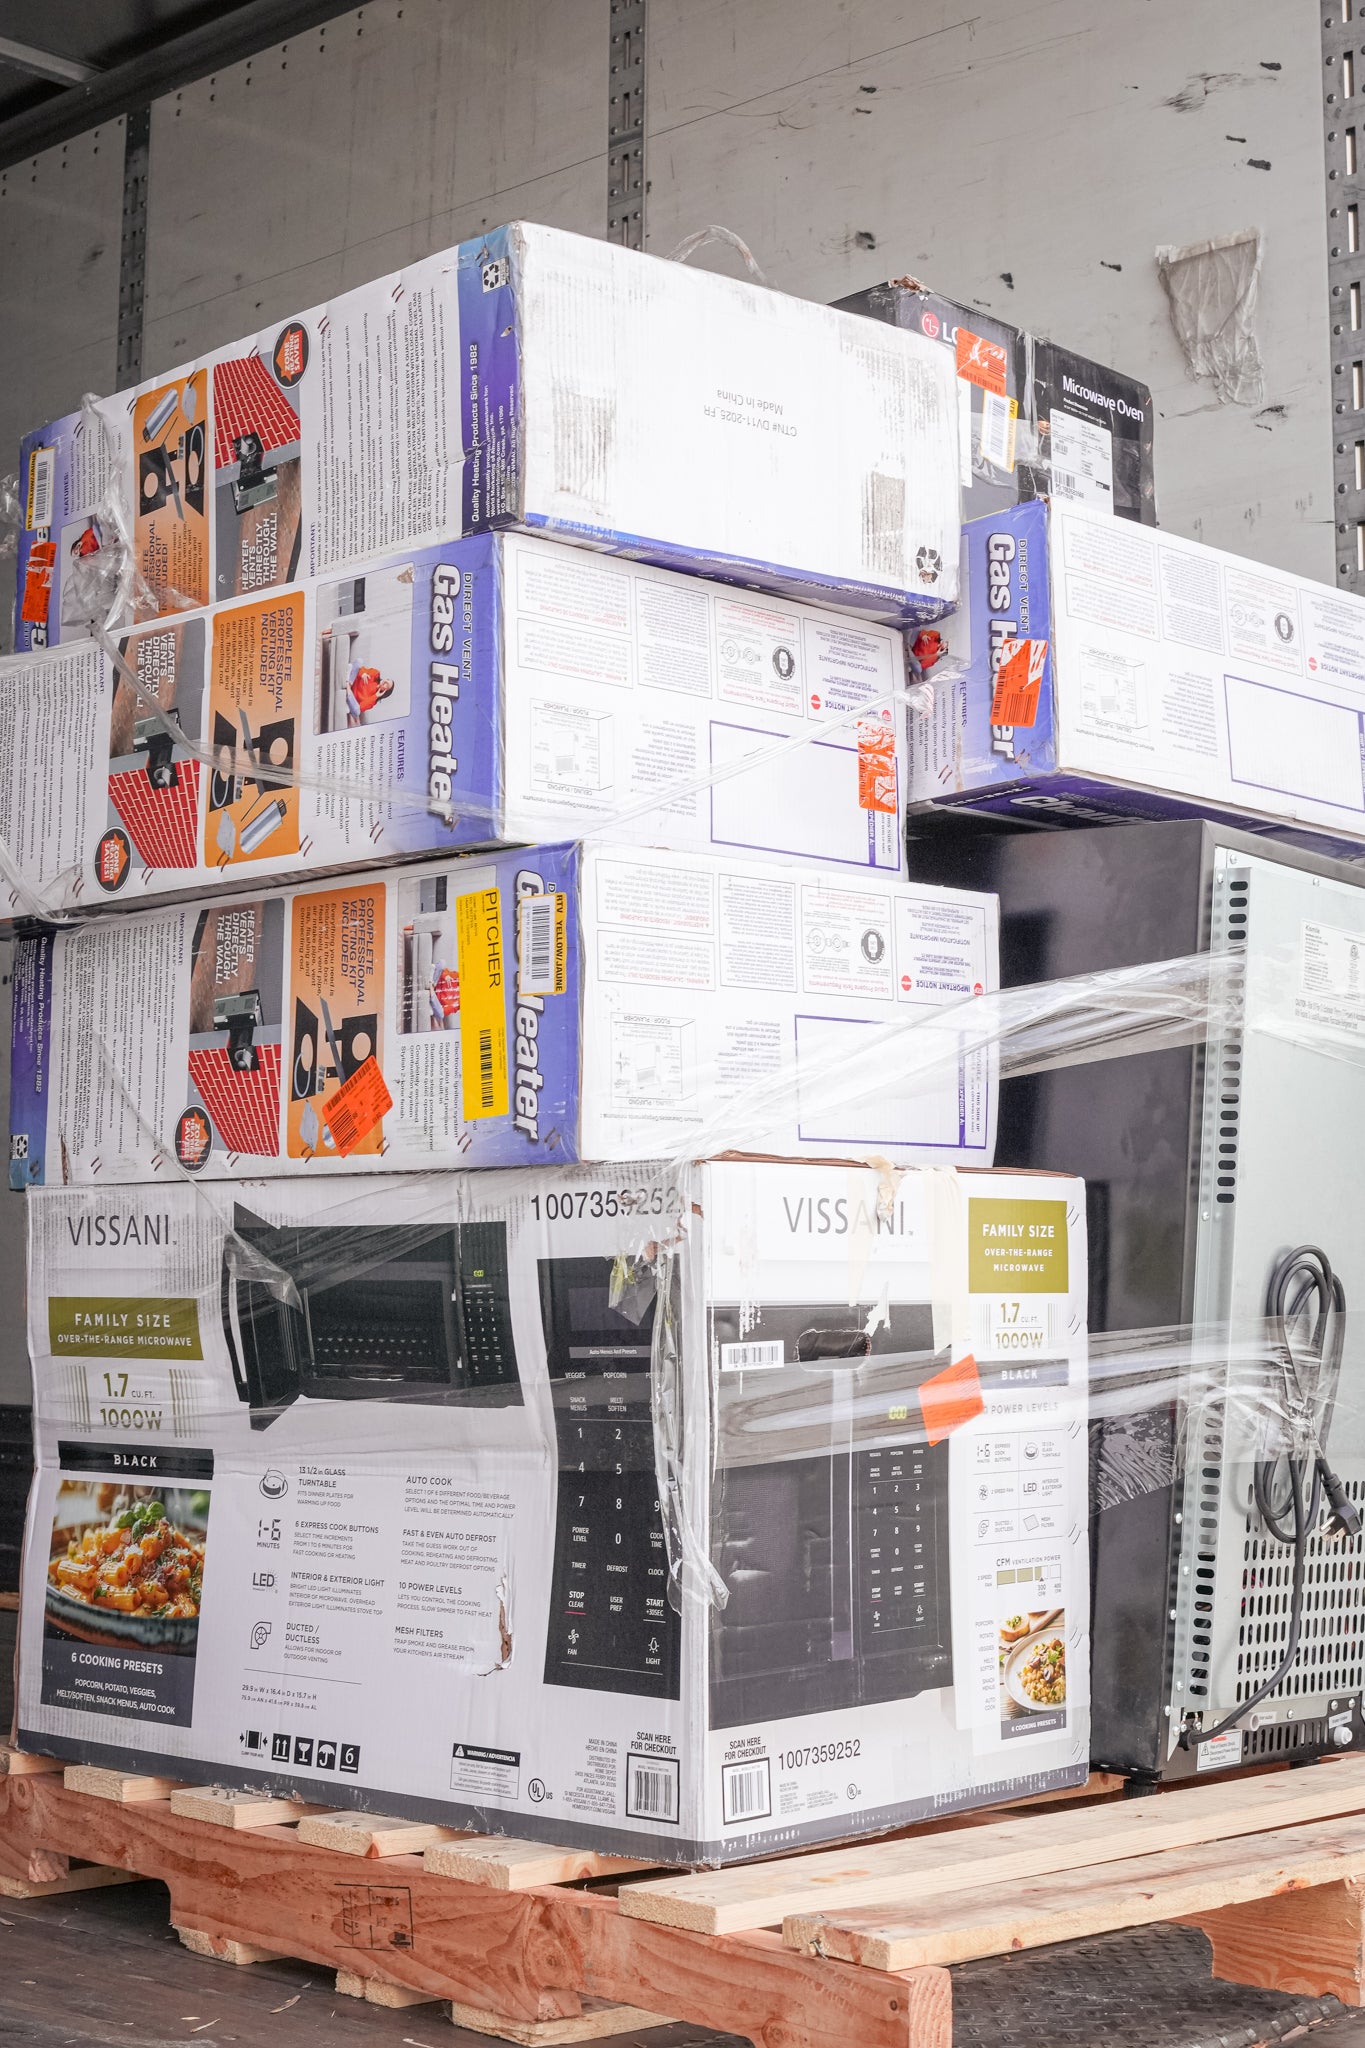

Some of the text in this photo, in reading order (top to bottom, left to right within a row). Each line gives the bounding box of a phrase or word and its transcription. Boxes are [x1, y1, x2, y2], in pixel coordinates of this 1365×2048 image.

[717, 389, 783, 415] Made In China
[1062, 375, 1116, 411] Microwave
[1116, 399, 1144, 423] Oven
[704, 405, 797, 437] CTN# DV11-2025_FR
[470, 344, 482, 522] Quality Heating Products Since 1982
[1019, 539, 1030, 634] DIRECT VENT
[462, 572, 473, 681] DIRECT VENT
[259, 613, 268, 686] INCLUDED!
[267, 611, 276, 694] VENTING KIT
[285, 607, 293, 682] COMPLETE
[989, 534, 1017, 760] Gas Her
[160, 634, 168, 677] VENTS
[167, 632, 175, 684] HEATER
[275, 609, 285, 713] PROFESSIONAL
[136, 640, 145, 707] THE WL!
[152, 636, 160, 699] DIRECTLY
[429, 564, 461, 824] Gas Heater
[397, 729, 405, 782] FEATURES:
[239, 911, 247, 955] VENTS
[328, 903, 337, 949] Everything
[230, 912, 239, 977] DIRECTLY
[246, 910, 255, 963] HEATER
[341, 901, 349, 977] INCLUDED!
[349, 900, 358, 987] VENTING KIT
[366, 897, 375, 975] COMPLETE
[485, 891, 502, 989] PITCHER
[216, 915, 224, 984] THE WALL!
[223, 914, 231, 980] THROUGH
[357, 898, 366, 1007] PROFESSIONAL
[555, 920, 563, 991] YELLOW/JAUNE
[916, 980, 970, 992] IMPORTANT NOTICE
[67, 1214, 169, 1246] VISSANI
[982, 1223, 1054, 1238] FAMILY SIZE
[984, 1248, 1053, 1257] OVER-THE-RANGE
[993, 1264, 1044, 1272] MICROWAVE
[75, 1313, 171, 1328] FAMILY SIZE
[1000, 1302, 1020, 1323] 1.7
[57, 1334, 192, 1346] OVER-THE-RANGE MICROWAVE
[995, 1332, 1043, 1349] 1000W
[1001, 1367, 1038, 1380] BLACK
[103, 1372, 155, 1398] 1.7 CU.FT.
[991, 1401, 1059, 1415] POWER LEVELS
[100, 1408, 162, 1430] 1000W
[577, 1428, 622, 1439] 1 2
[114, 1454, 157, 1468] BLACK
[578, 1462, 622, 1475] 4 5
[299, 1467, 305, 1475] 13
[306, 1467, 317, 1476] 1/2
[324, 1468, 346, 1477] GLASS
[298, 1479, 337, 1488] TURNTABLE
[406, 1476, 452, 1486] AUTO COOK
[578, 1496, 660, 1512] 7 8 9
[295, 1520, 379, 1534] 6 EXPRESS COOK BUTTONS
[403, 1529, 418, 1537] FAST
[426, 1530, 443, 1539] EVEN
[446, 1532, 464, 1541] AUTO
[465, 1534, 496, 1543] DEFROST
[615, 1533, 621, 1544] 0
[256, 1542, 280, 1550] MINUTES
[606, 1565, 628, 1573] DEFROST
[648, 1568, 664, 1576] CLOCK
[252, 1572, 274, 1587] LED
[291, 1571, 384, 1587] INTERIOR & EXTERIOR LIGHT
[399, 1581, 462, 1595] 10 POWER LEVELS
[569, 1590, 585, 1599] STOP
[568, 1600, 584, 1609] CLEAR
[646, 1598, 664, 1607] START
[286, 1622, 313, 1633] DUCTED
[395, 1626, 443, 1639] MESH FILTERS
[285, 1634, 319, 1645] DUCTLESS
[567, 1648, 578, 1656] FAN
[71, 1652, 163, 1675] 6 COOKING PRESETS
[646, 1657, 661, 1665] LIGHT
[74, 1678, 156, 1699] POPCORN, POTATO, VEGGIES,
[56, 1688, 175, 1715] MELT/SOFTEN, SNACK MENUS, AUTO COOK
[637, 1731, 671, 1744] SCAN HERE
[730, 1737, 761, 1750] SCAN HERE
[346, 1748, 354, 1764] 6
[630, 1741, 677, 1755] FOR CHECKOUT
[725, 1746, 766, 1760] FOR CHECKOUT
[778, 1738, 862, 1771] 1007359252
